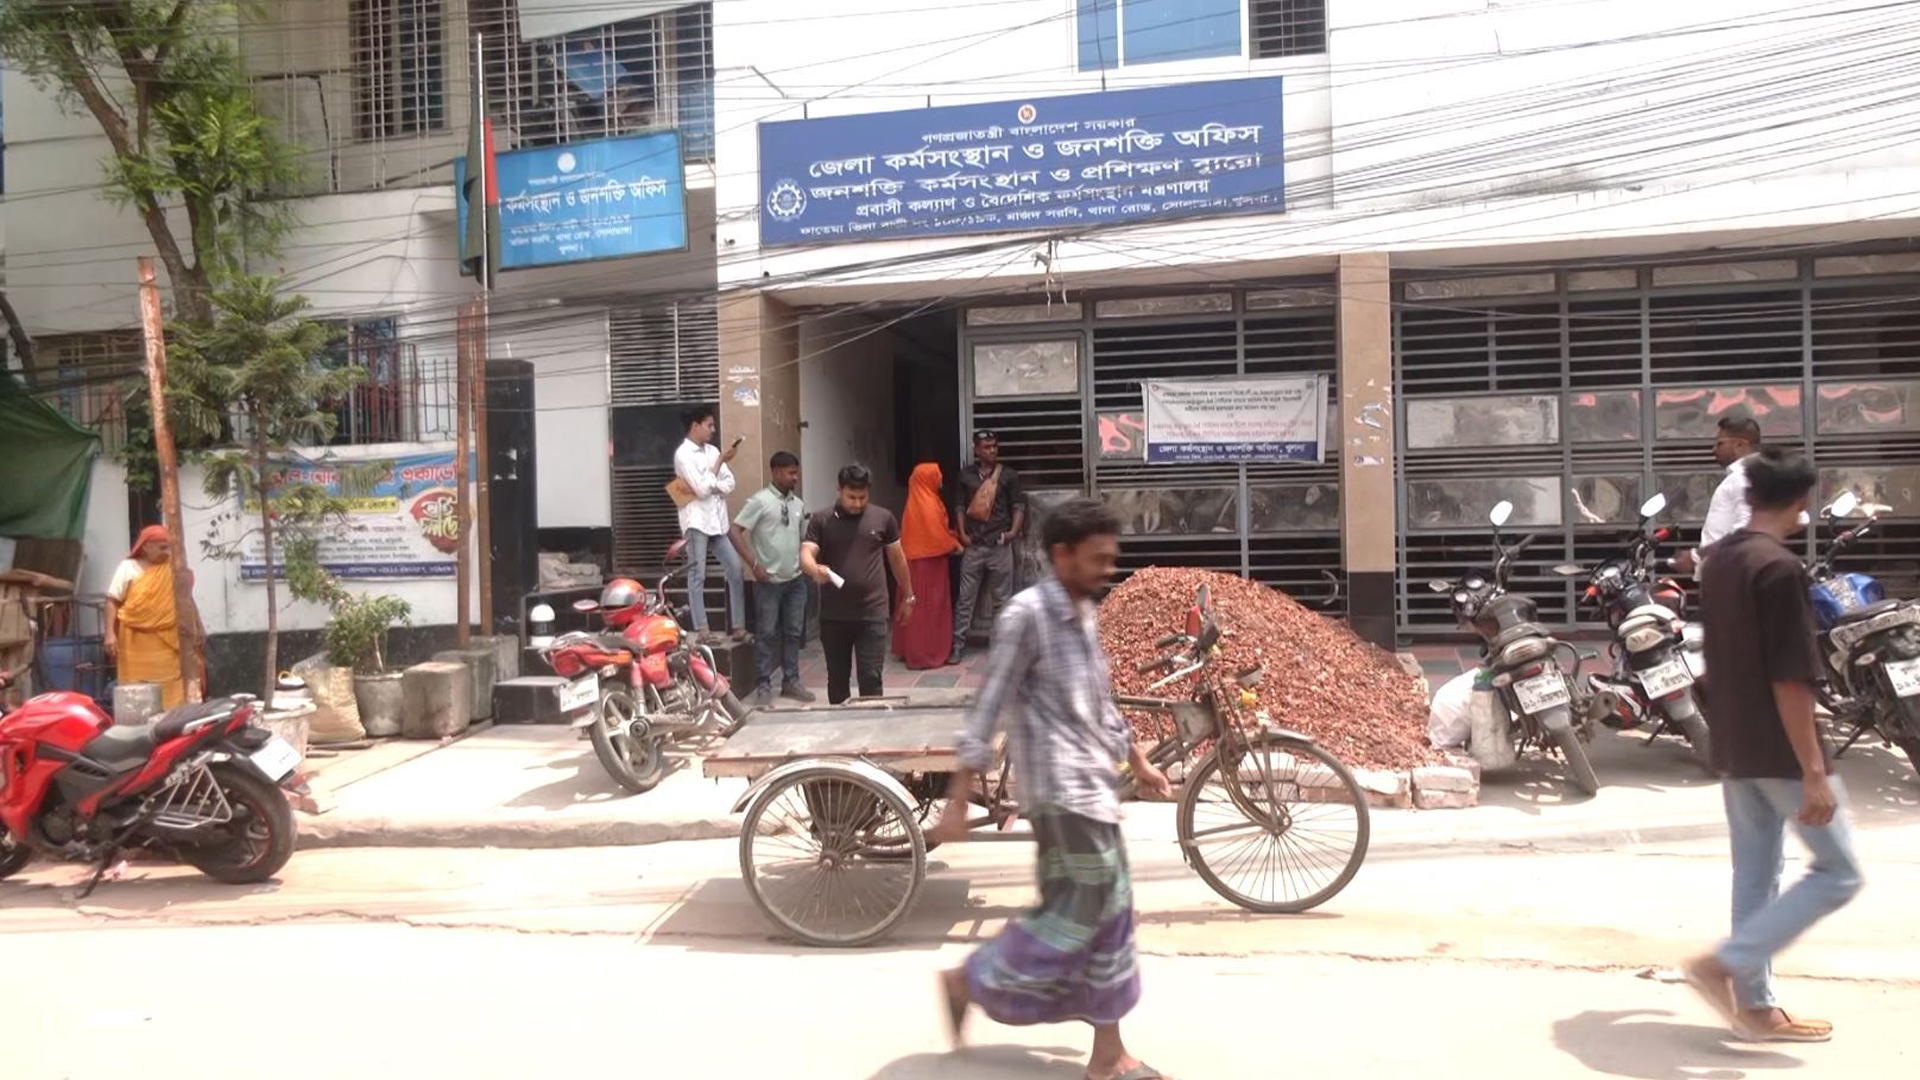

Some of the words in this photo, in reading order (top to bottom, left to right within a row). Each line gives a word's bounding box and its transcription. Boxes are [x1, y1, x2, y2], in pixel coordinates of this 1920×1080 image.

[1010, 121, 1078, 137] বাংলাদেশ
[1084, 117, 1137, 131] সরকার
[809, 154, 876, 178] জেলা
[884, 144, 1013, 170] কর্মসংস্থান
[1022, 143, 1045, 160] ও
[1054, 129, 1165, 157] জনশক্তি
[1172, 122, 1264, 147] অফিস
[505, 188, 561, 214] কর্মসংস্থান
[565, 193, 576, 207] ও
[579, 178, 626, 203] জনশক্তি
[630, 175, 667, 197] অফিস
[809, 178, 906, 201] জনশক্তি
[918, 170, 1039, 191] কর্মসংস্থান
[1050, 168, 1071, 183] ও
[1081, 159, 1183, 182] প্রশিক্ষণ
[856, 197, 901, 218] প্রবাসী
[907, 196, 957, 214] কল্যাণ
[963, 196, 976, 209] ও
[981, 188, 1051, 209] বৈদেশিক
